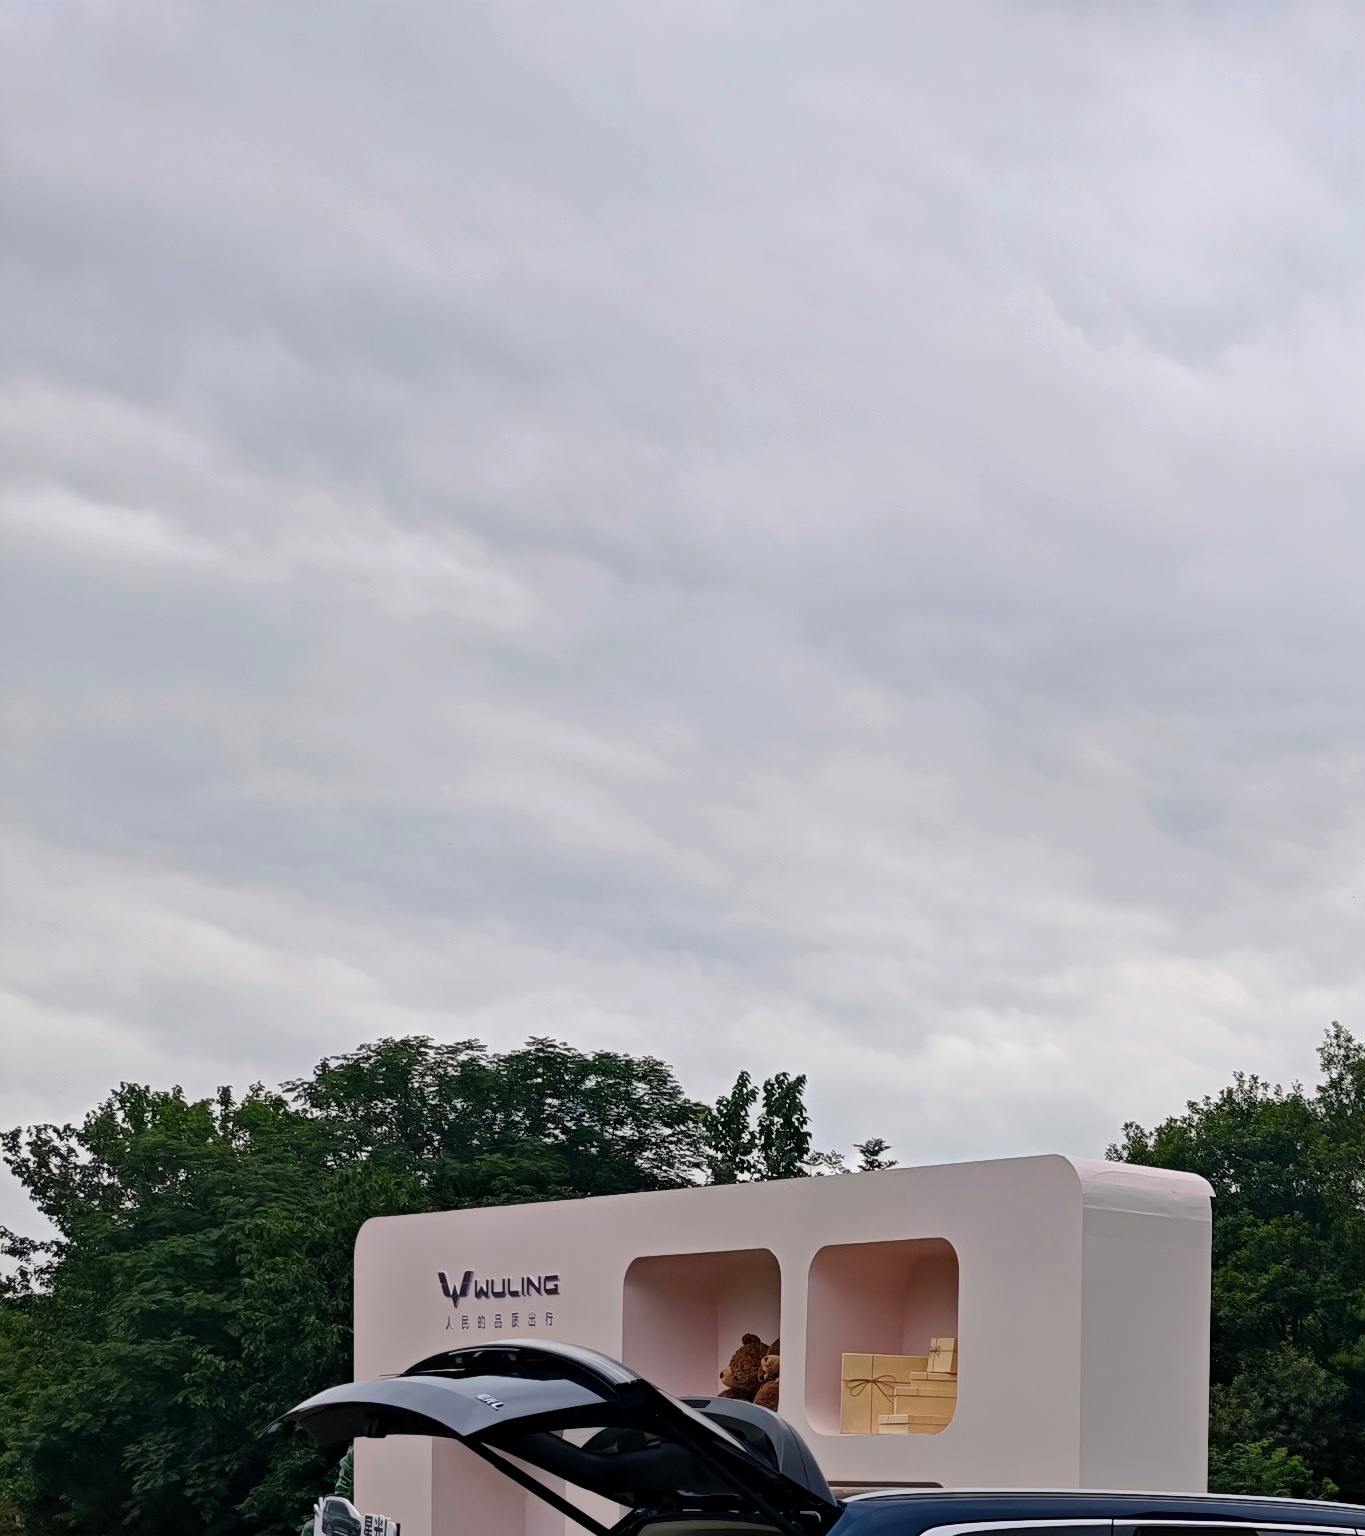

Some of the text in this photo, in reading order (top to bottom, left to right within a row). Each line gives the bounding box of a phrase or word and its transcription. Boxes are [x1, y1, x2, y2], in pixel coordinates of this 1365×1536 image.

[474, 1274, 561, 1300] WULING
[445, 1311, 554, 1331] 人民的品质出行
